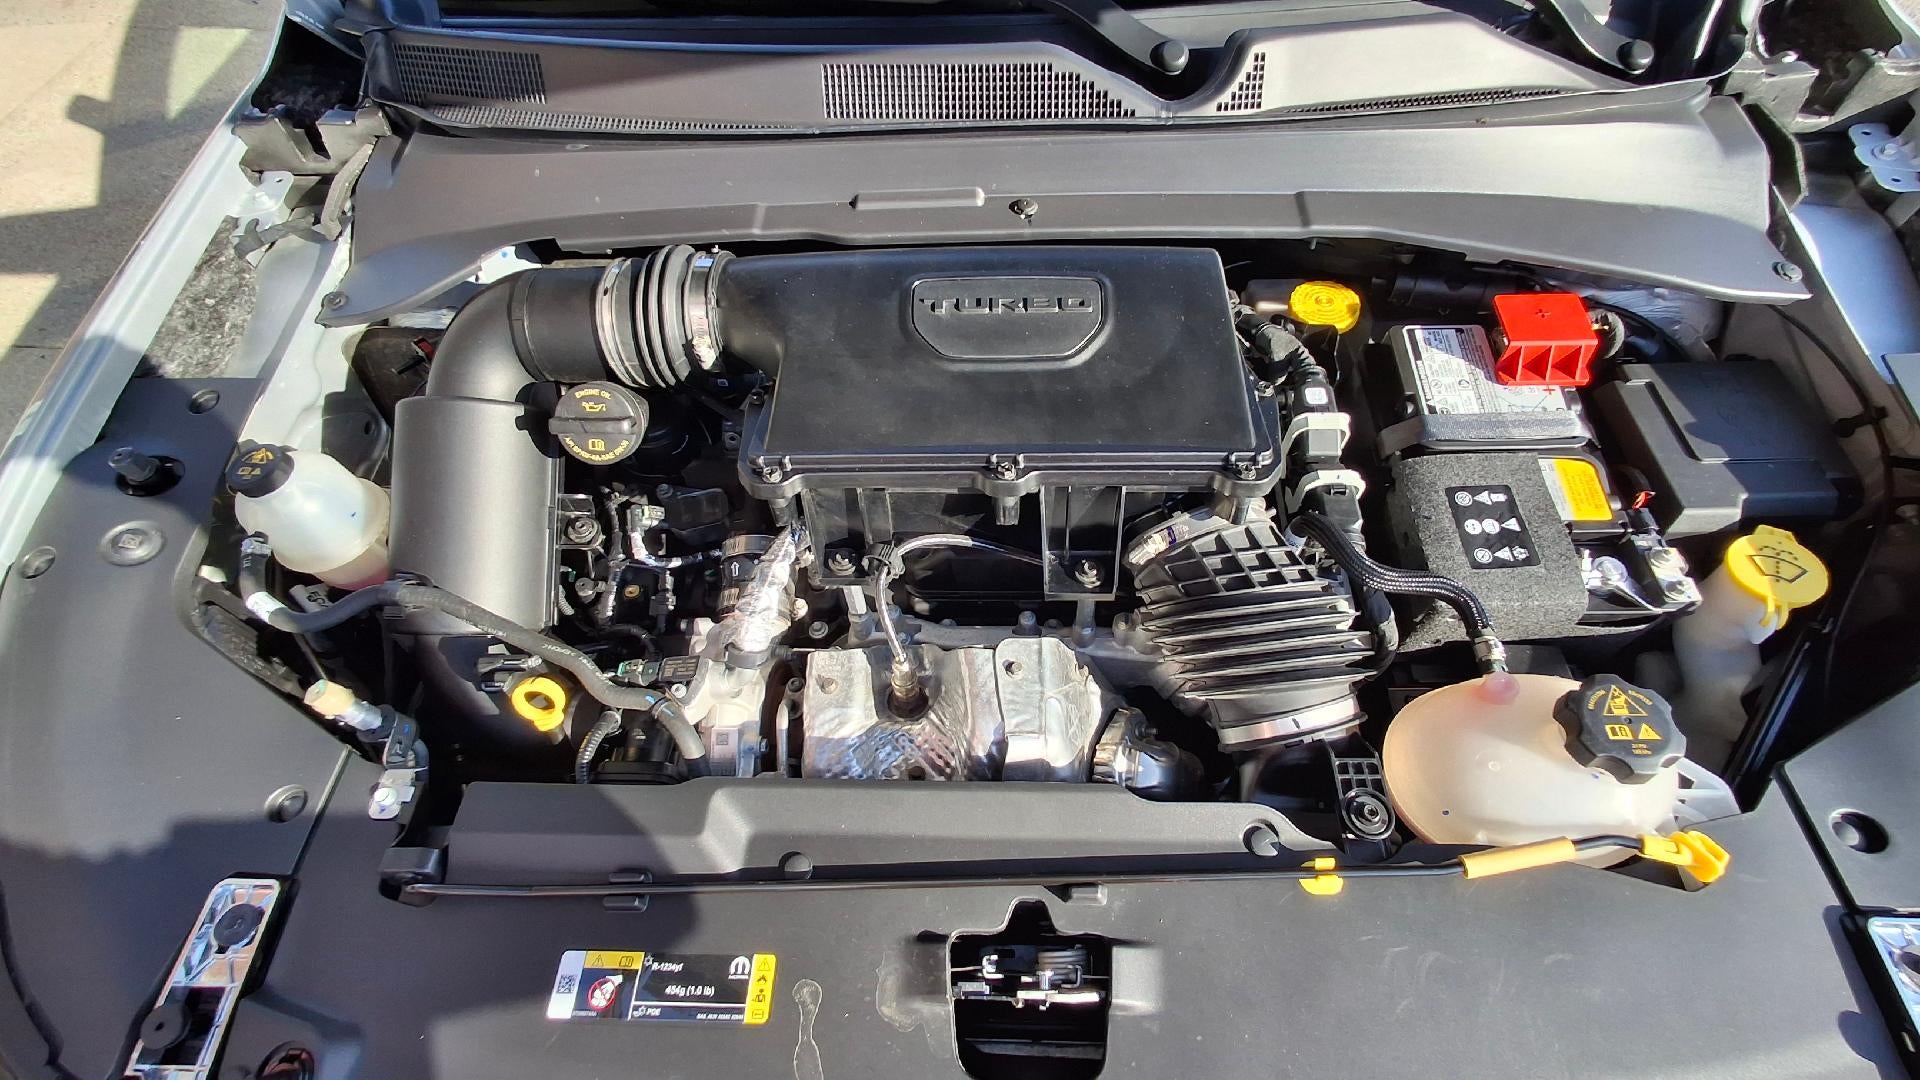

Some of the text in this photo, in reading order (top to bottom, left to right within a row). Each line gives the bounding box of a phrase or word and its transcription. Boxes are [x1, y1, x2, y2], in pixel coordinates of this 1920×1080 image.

[919, 297, 1093, 314] TURBO
[575, 389, 612, 400] ENGINE OIL
[651, 962, 684, 973] R-1234yf
[664, 985, 715, 998] 454g (1.0 lb)
